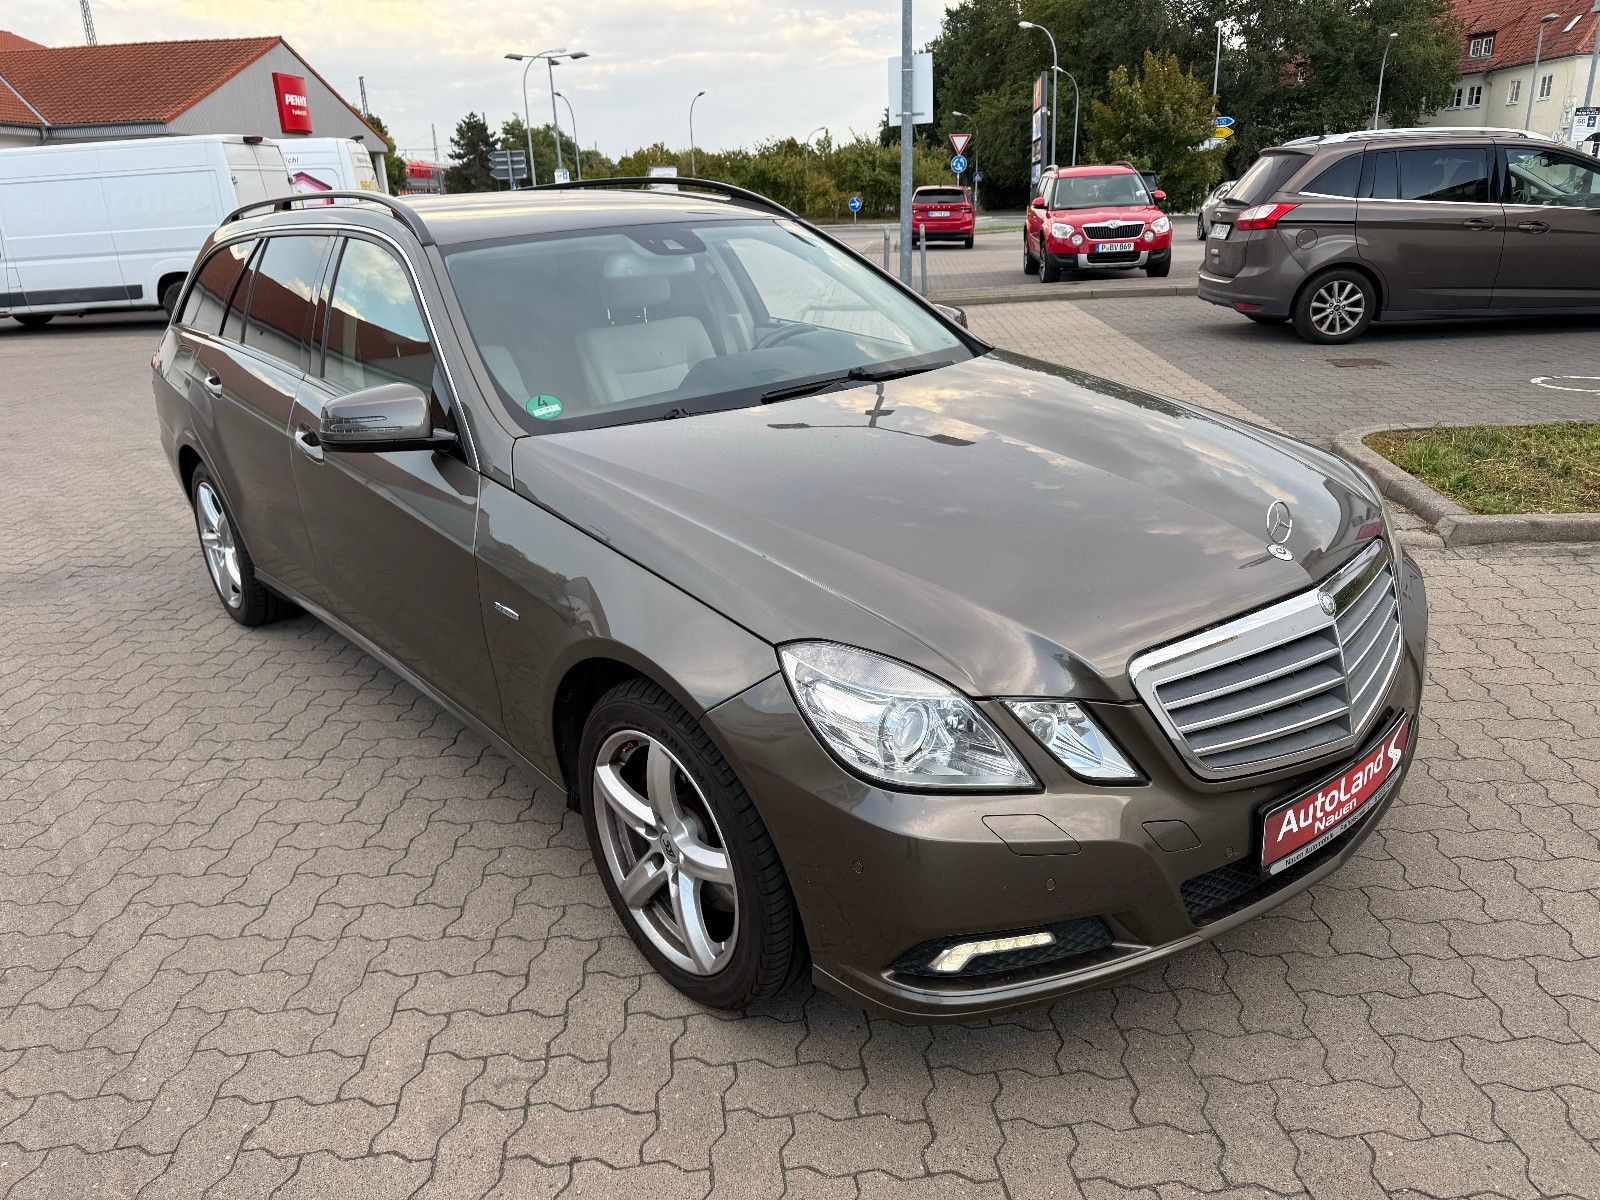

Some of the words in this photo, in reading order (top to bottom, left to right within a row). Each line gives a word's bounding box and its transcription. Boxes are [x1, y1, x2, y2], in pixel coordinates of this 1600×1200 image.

[285, 93, 307, 106] PENNY
[1277, 745, 1385, 842] AutoLand
[1314, 797, 1357, 834] Nauen
